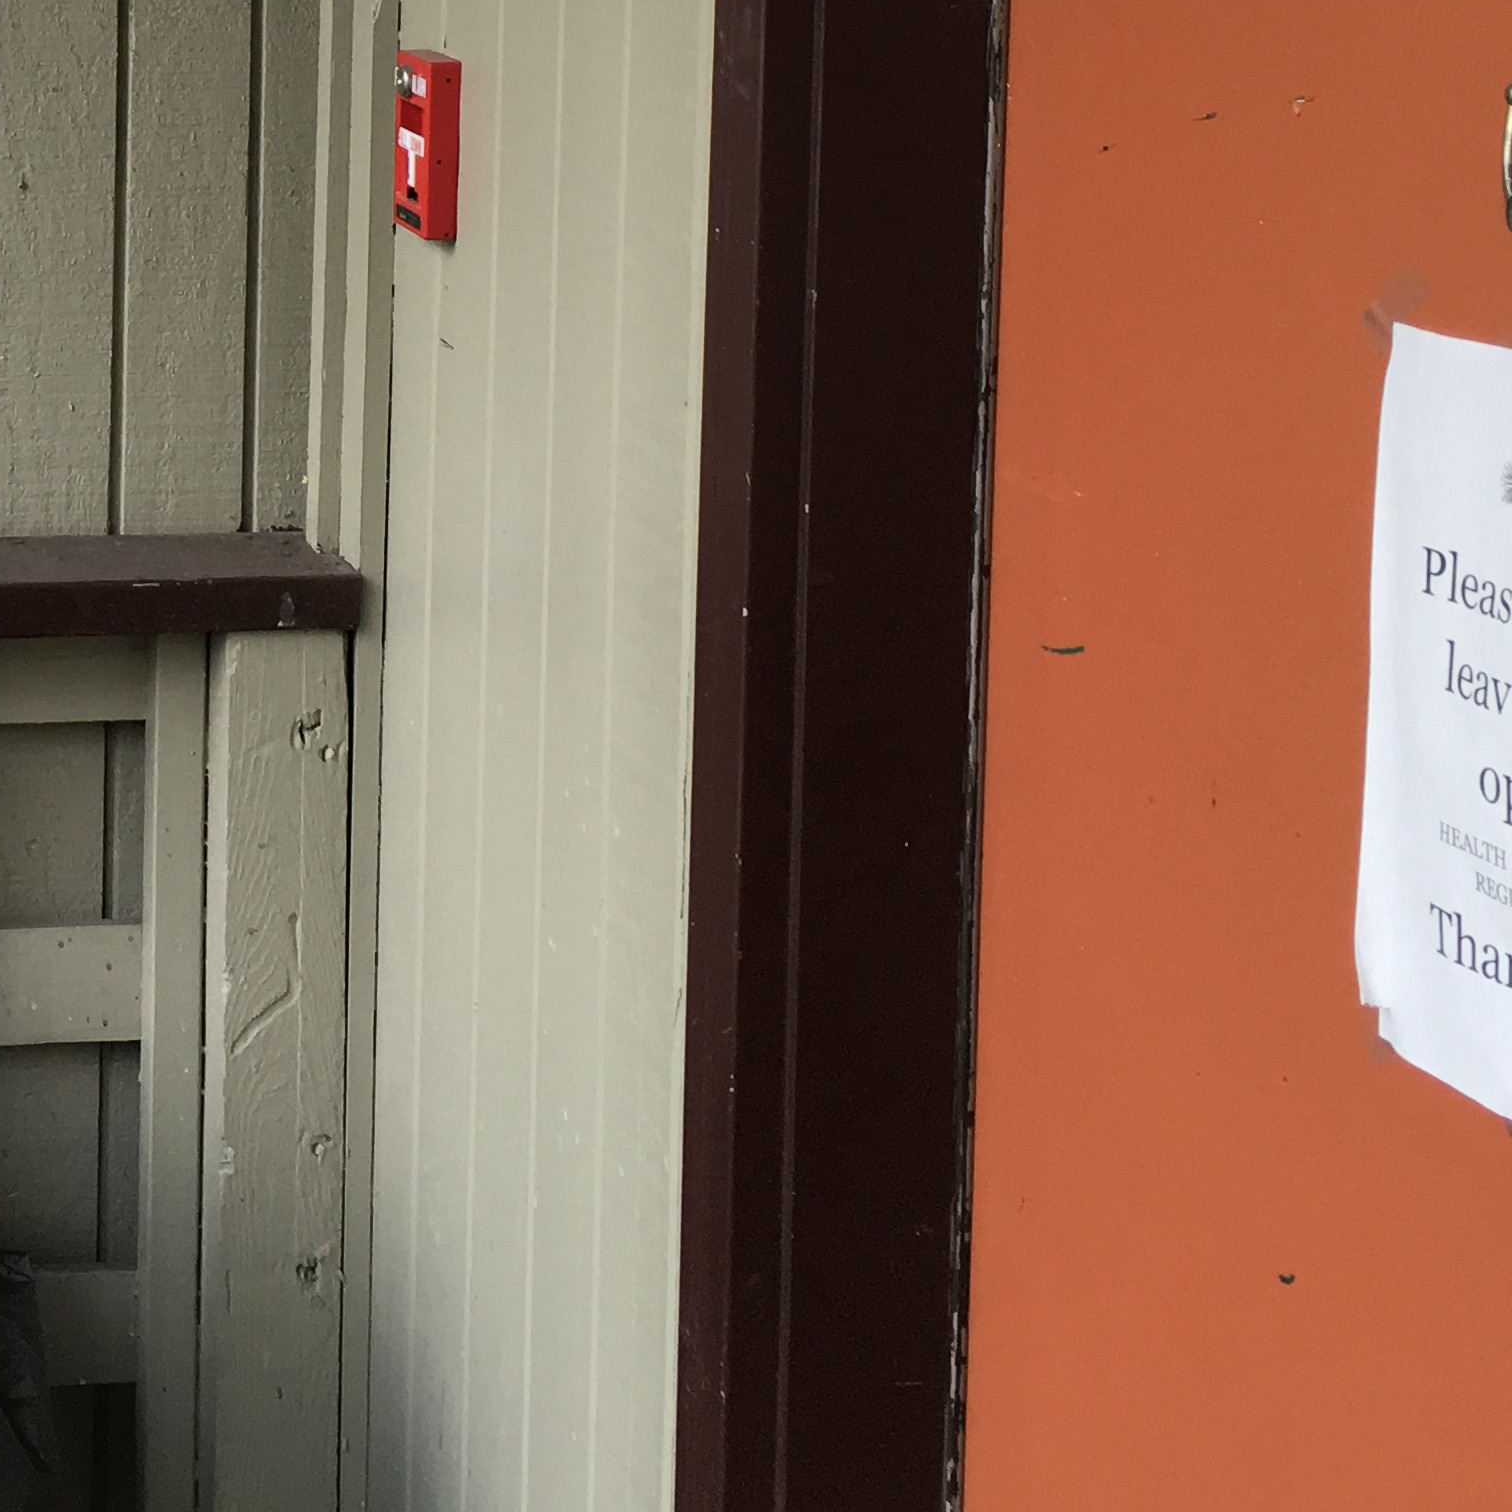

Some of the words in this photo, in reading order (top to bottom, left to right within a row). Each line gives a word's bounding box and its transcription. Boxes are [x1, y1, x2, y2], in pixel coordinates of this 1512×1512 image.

[1422, 546, 1512, 624] Pleas
[1445, 638, 1512, 715] leav
[1439, 820, 1507, 871] HEALTH
